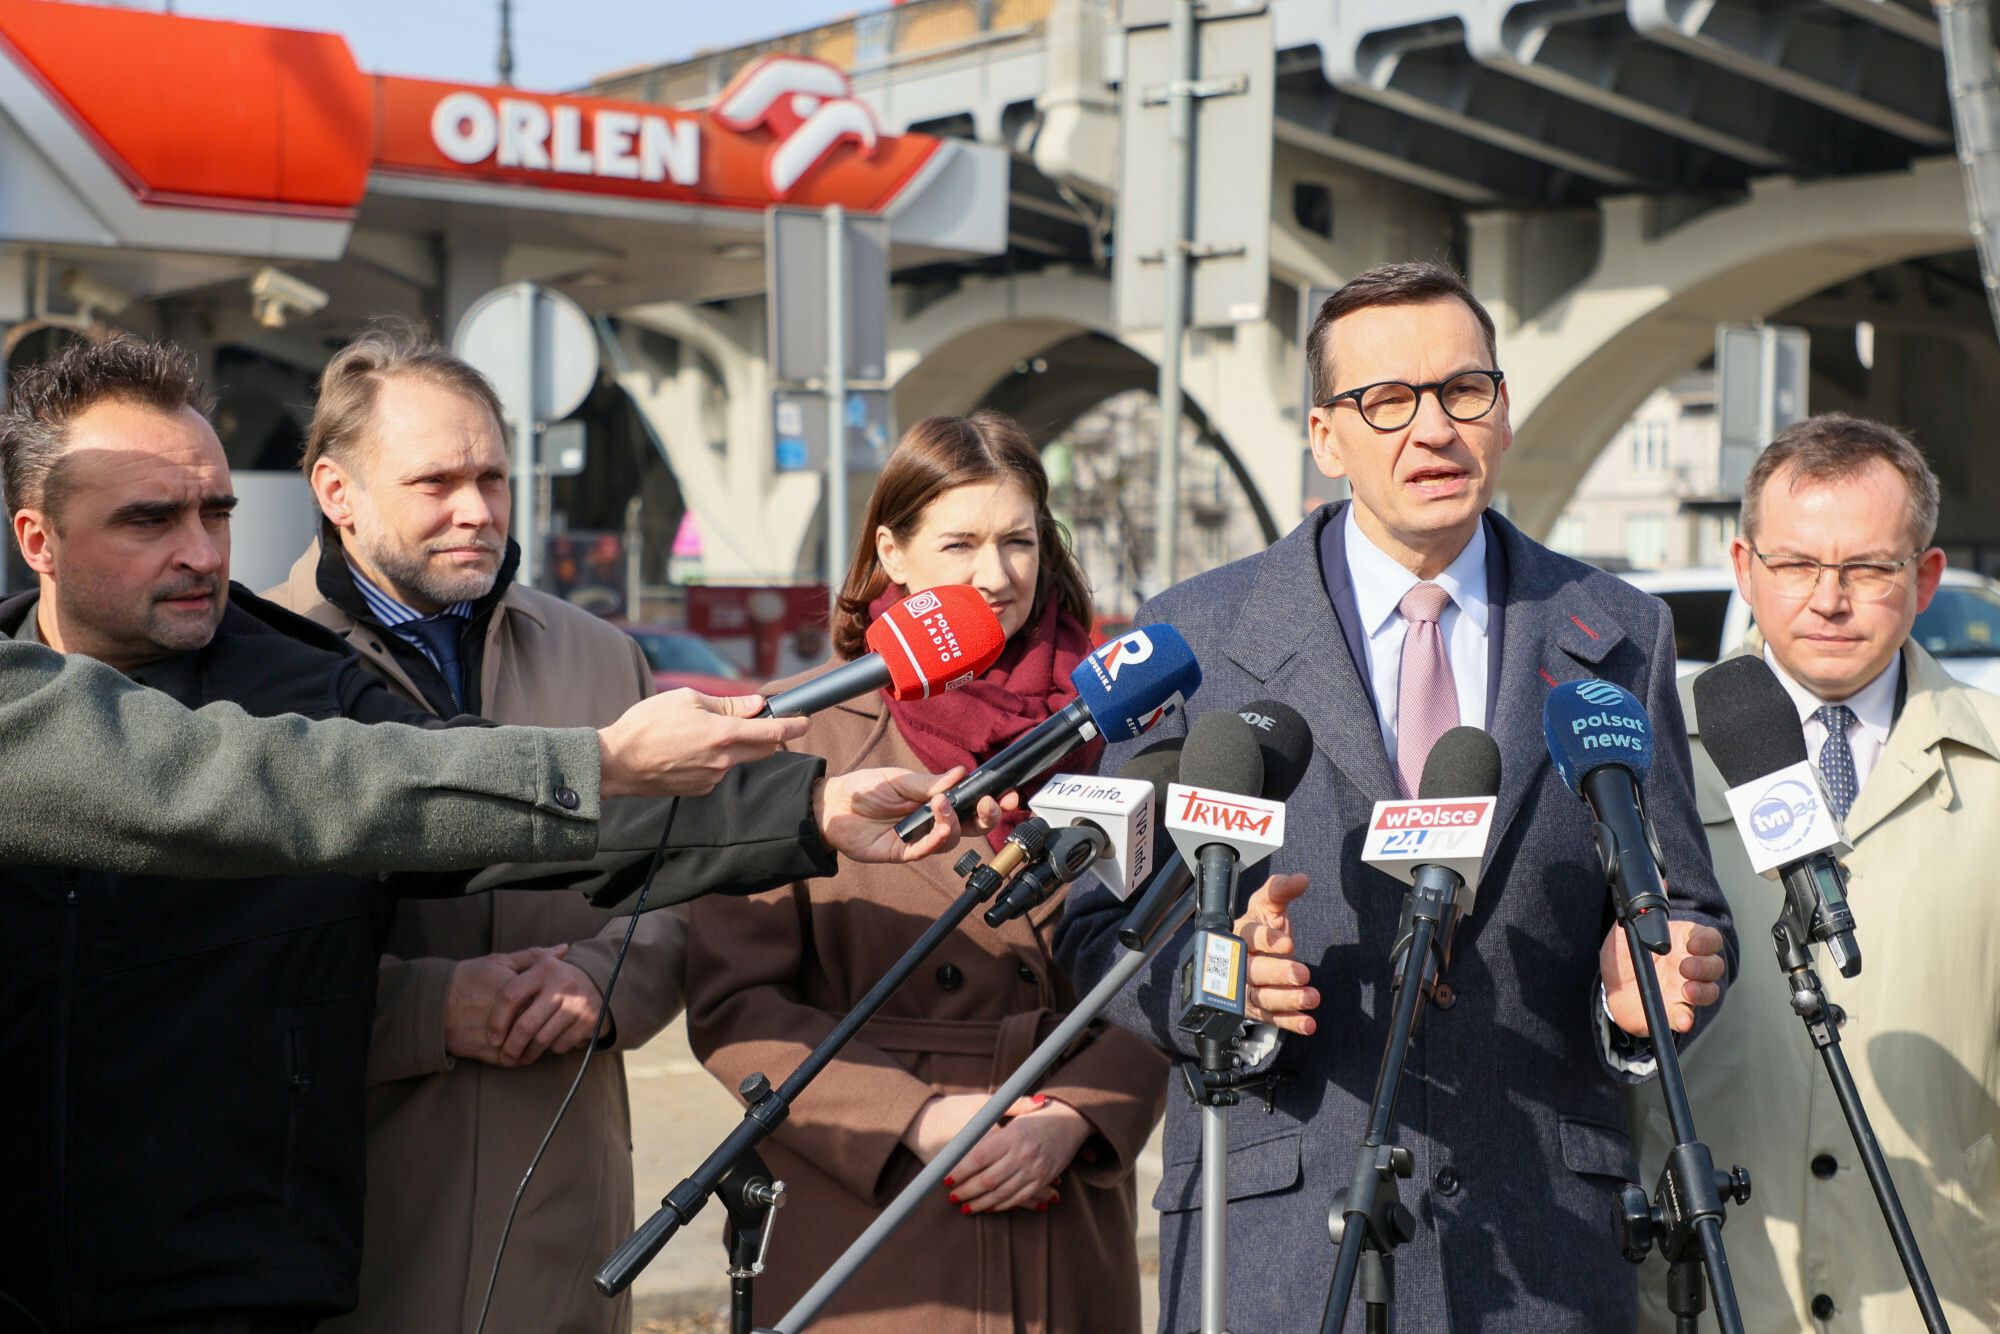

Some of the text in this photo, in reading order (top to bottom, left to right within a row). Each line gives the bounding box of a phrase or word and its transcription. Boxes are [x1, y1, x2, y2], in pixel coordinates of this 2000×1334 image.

[431, 91, 700, 186] ORLEN
[922, 617, 951, 662] RADIO
[933, 612, 962, 659] POLSKIE
[1572, 712, 1645, 735] polsat
[1582, 733, 1643, 751] news
[1178, 791, 1275, 836] TRWAM
[1385, 806, 1477, 828] wPolsce
